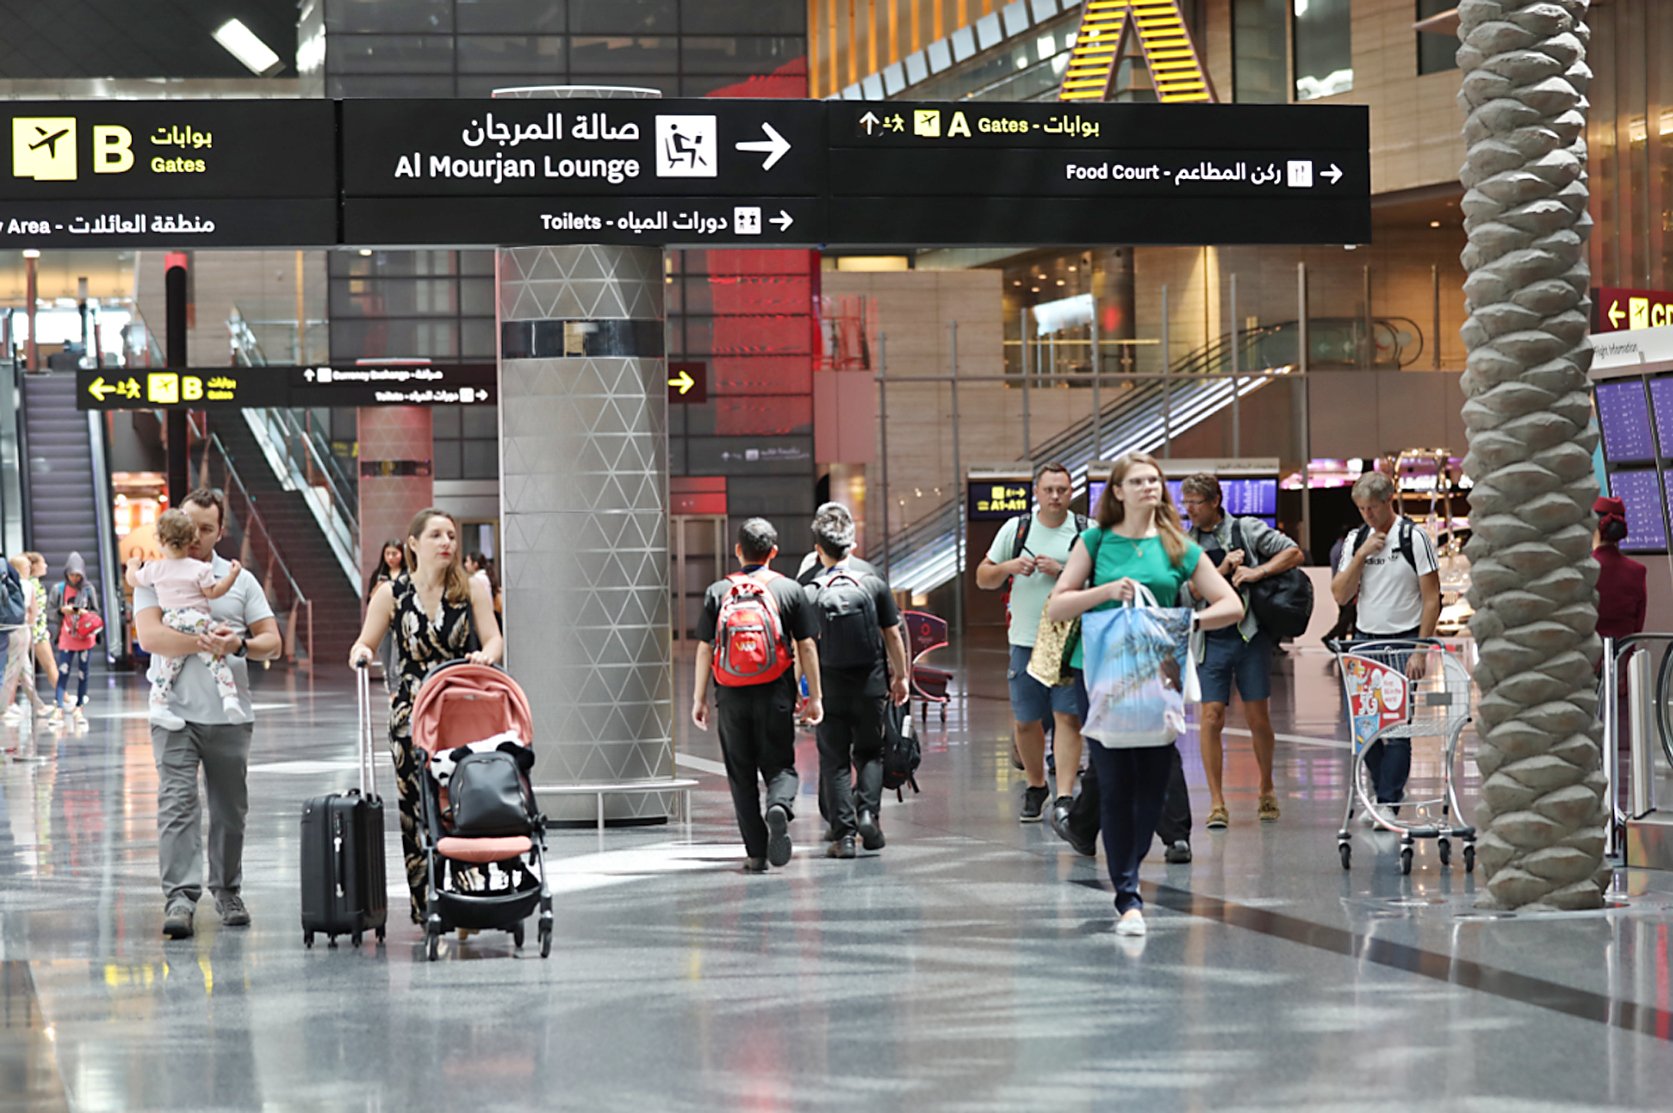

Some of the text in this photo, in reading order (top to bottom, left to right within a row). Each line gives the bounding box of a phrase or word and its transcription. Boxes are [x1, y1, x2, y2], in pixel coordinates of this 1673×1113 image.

[151, 125, 213, 148] بوابات
[463, 113, 639, 147] صالة المرجان
[948, 112, 971, 137] A
[978, 118, 1028, 133] Gates
[1044, 114, 1099, 138] بوابات
[93, 125, 134, 173] B
[151, 157, 206, 172] Gates
[395, 152, 640, 185] Al Mourjan Lounge
[1067, 163, 1108, 179] Food
[1113, 164, 1159, 180] Court
[1175, 162, 1246, 185] المطاعم
[1251, 164, 1281, 185] ركن
[7, 219, 51, 235] Area
[68, 213, 146, 234] العائلات
[151, 214, 215, 233] منطقة
[541, 212, 602, 230] Toilets
[618, 211, 667, 234] المياه
[673, 211, 727, 234] دورات
[182, 376, 204, 400] B
